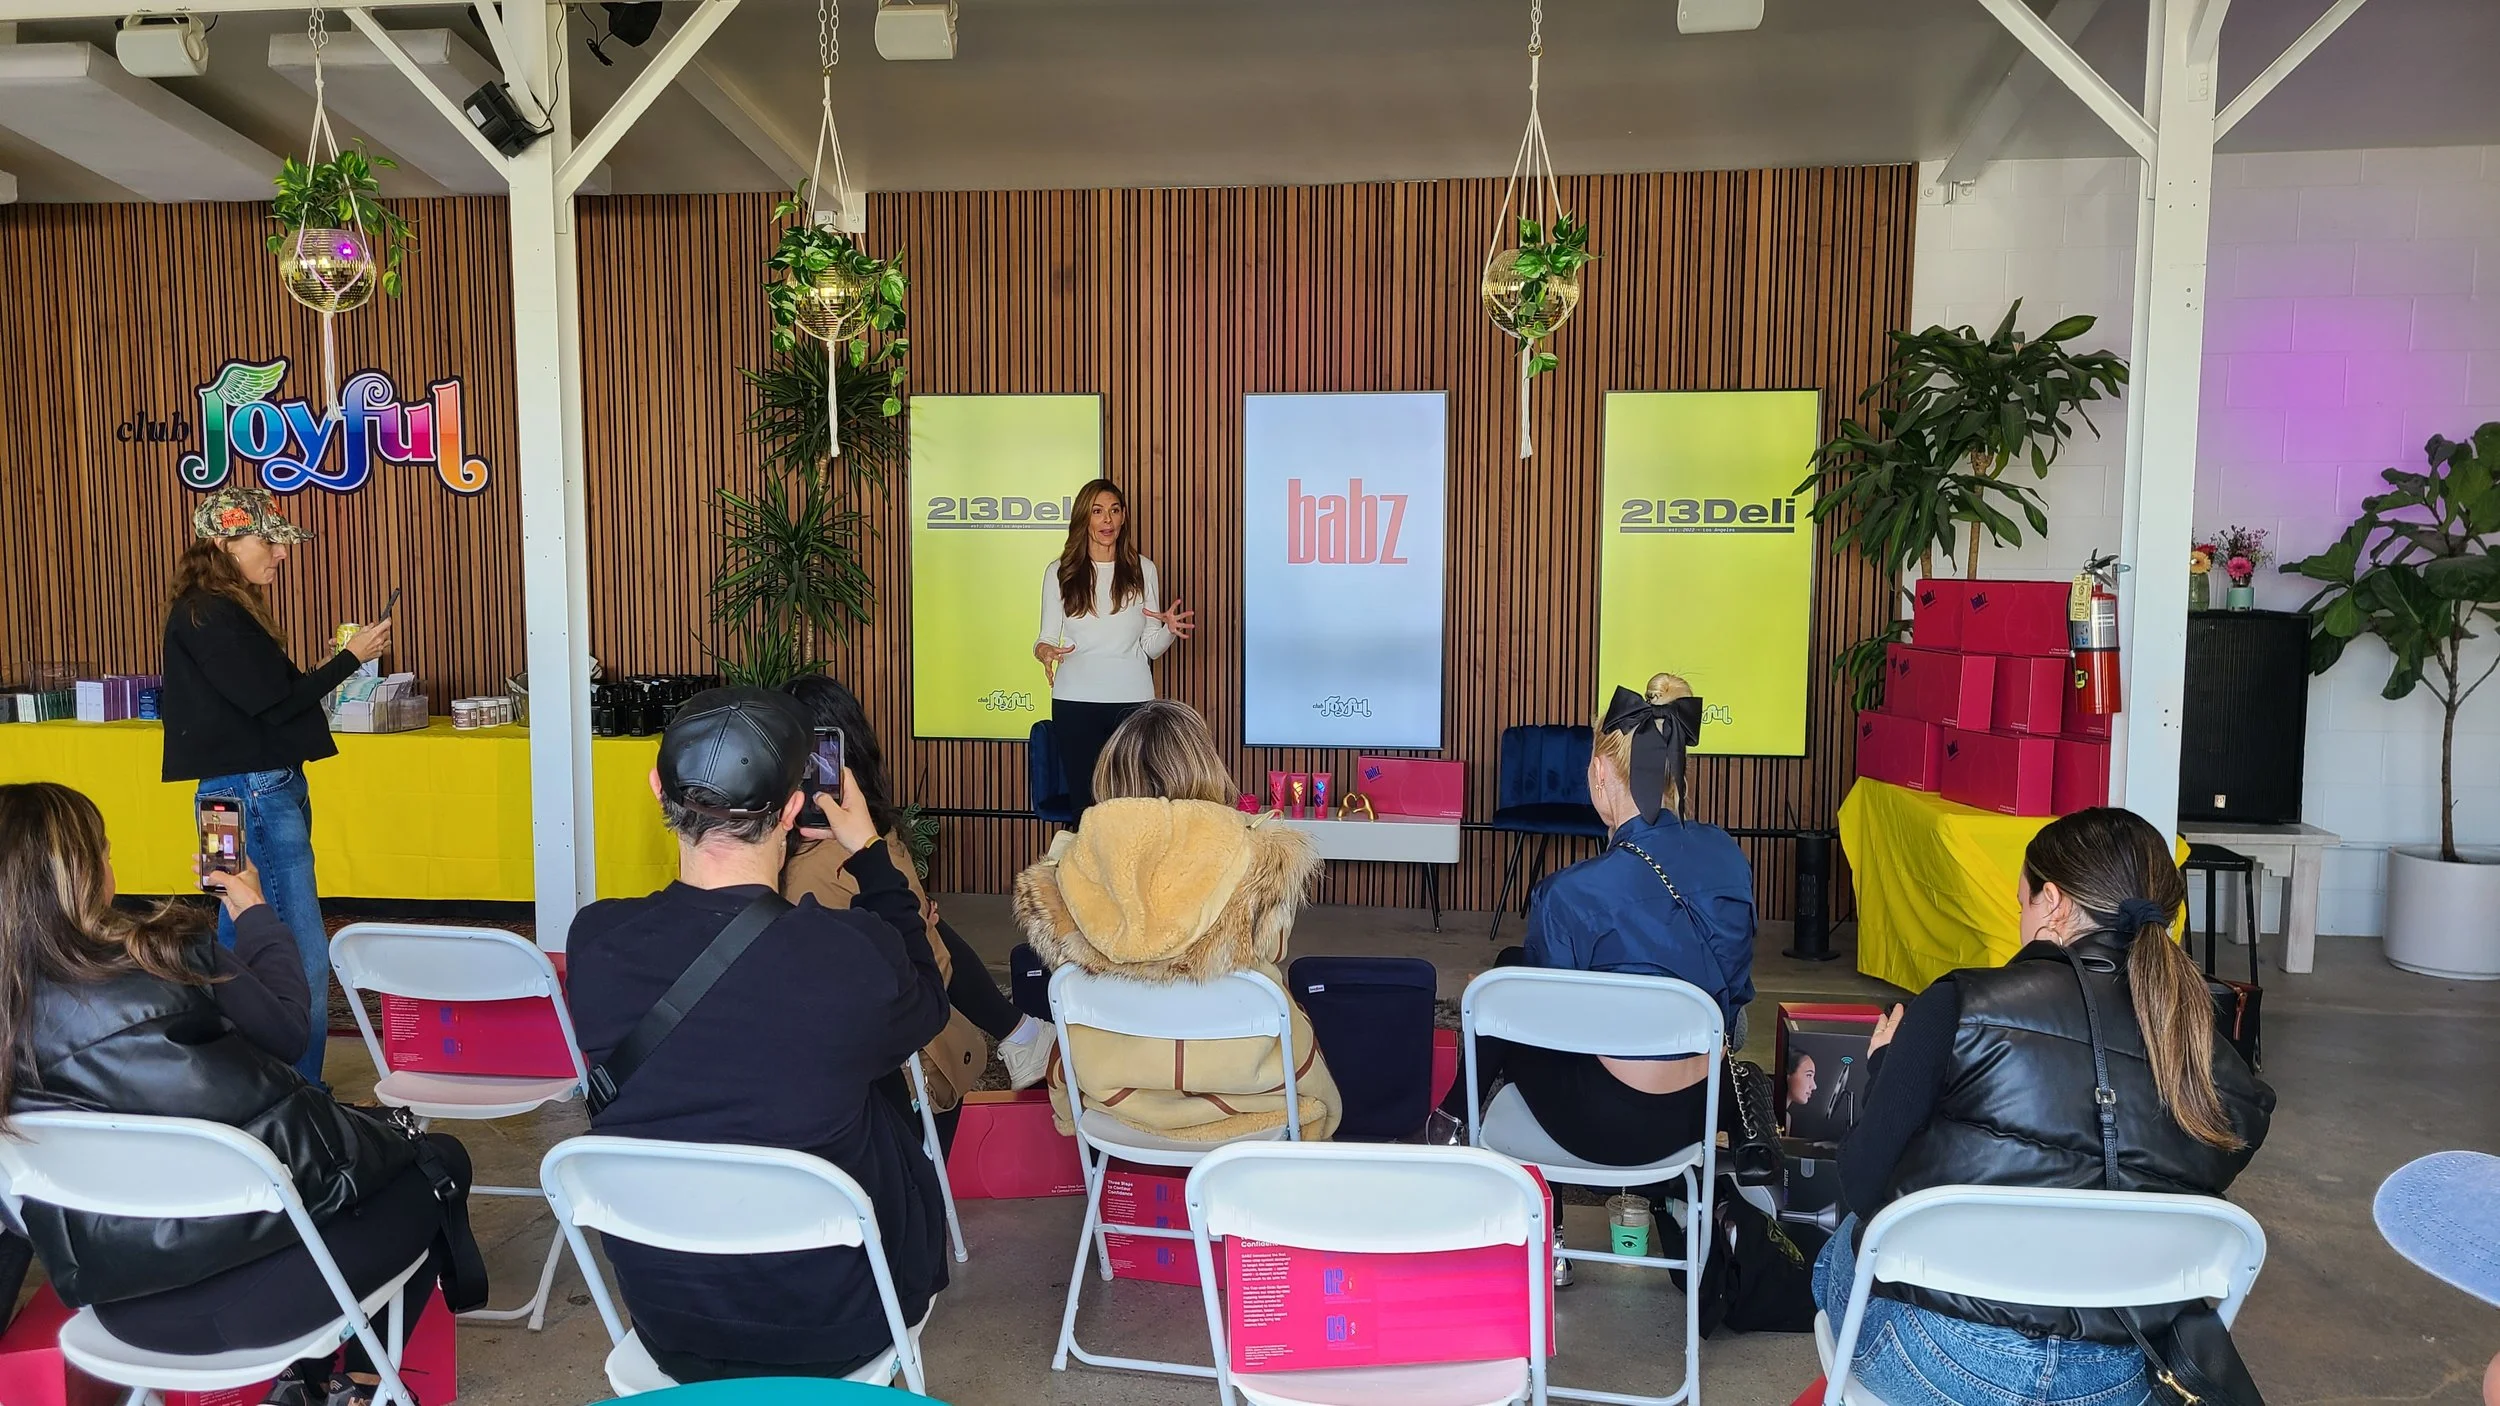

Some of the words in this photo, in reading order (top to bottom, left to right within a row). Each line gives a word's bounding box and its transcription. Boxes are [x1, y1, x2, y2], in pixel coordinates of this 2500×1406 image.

[116, 411, 191, 442] club
[177, 356, 493, 495] Joyful
[927, 496, 1072, 521] 213Del
[1287, 478, 1409, 564] babz
[1620, 498, 1796, 524] 213Deli
[1321, 696, 1372, 717] Joyful
